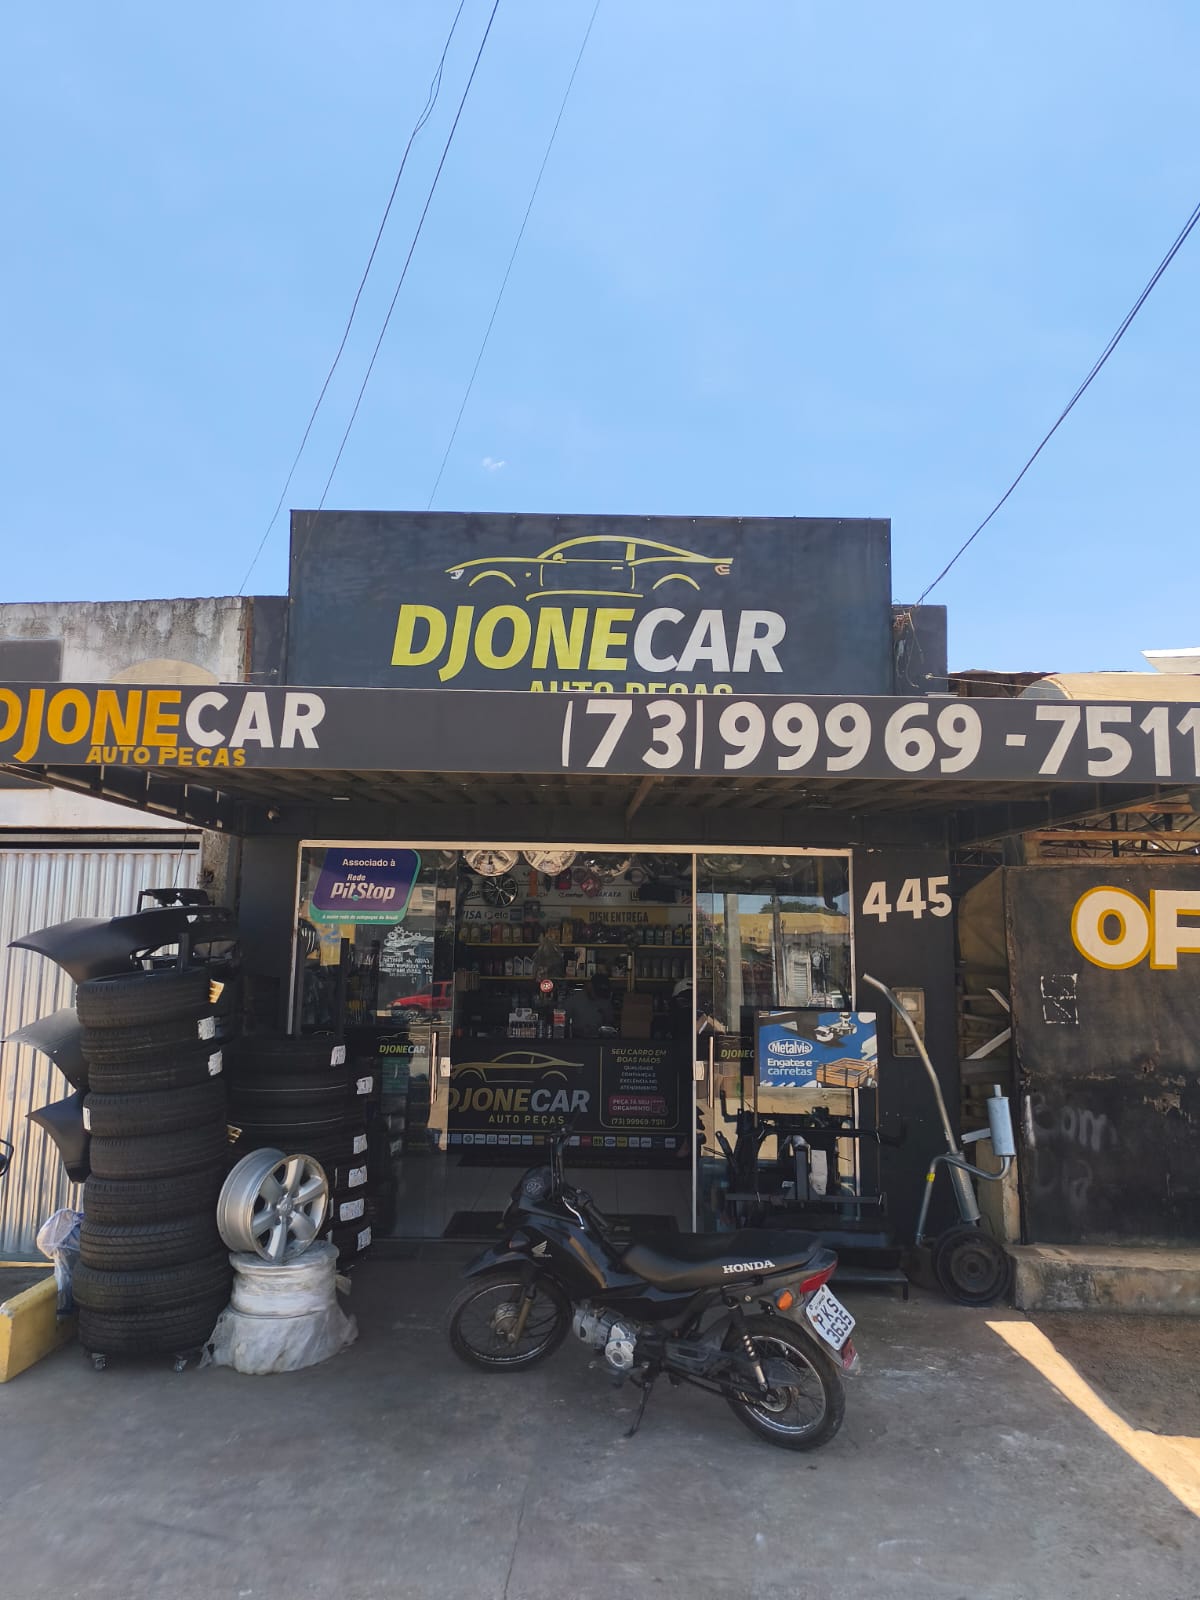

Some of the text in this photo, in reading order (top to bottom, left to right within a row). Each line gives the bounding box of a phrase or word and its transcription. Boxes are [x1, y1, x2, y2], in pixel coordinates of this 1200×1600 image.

[391, 604, 786, 682] DJONECAR
[85, 746, 246, 767] AUTO PEÇAS
[342, 858, 396, 867] Associado à
[346, 873, 367, 882] Rede
[330, 882, 396, 903] PitStop
[862, 876, 952, 923] 445
[611, 911, 648, 922] ENTREGA
[378, 1044, 426, 1055] DJONECAR
[771, 1040, 810, 1054] Metalvis
[767, 1058, 804, 1068] Engates
[768, 1067, 813, 1076] carretas
[488, 1114, 566, 1126] AUTO PEÇAS
[722, 1259, 776, 1274] HONDA
[816, 1297, 839, 1330] PKS
[826, 1310, 852, 1344] 3635
